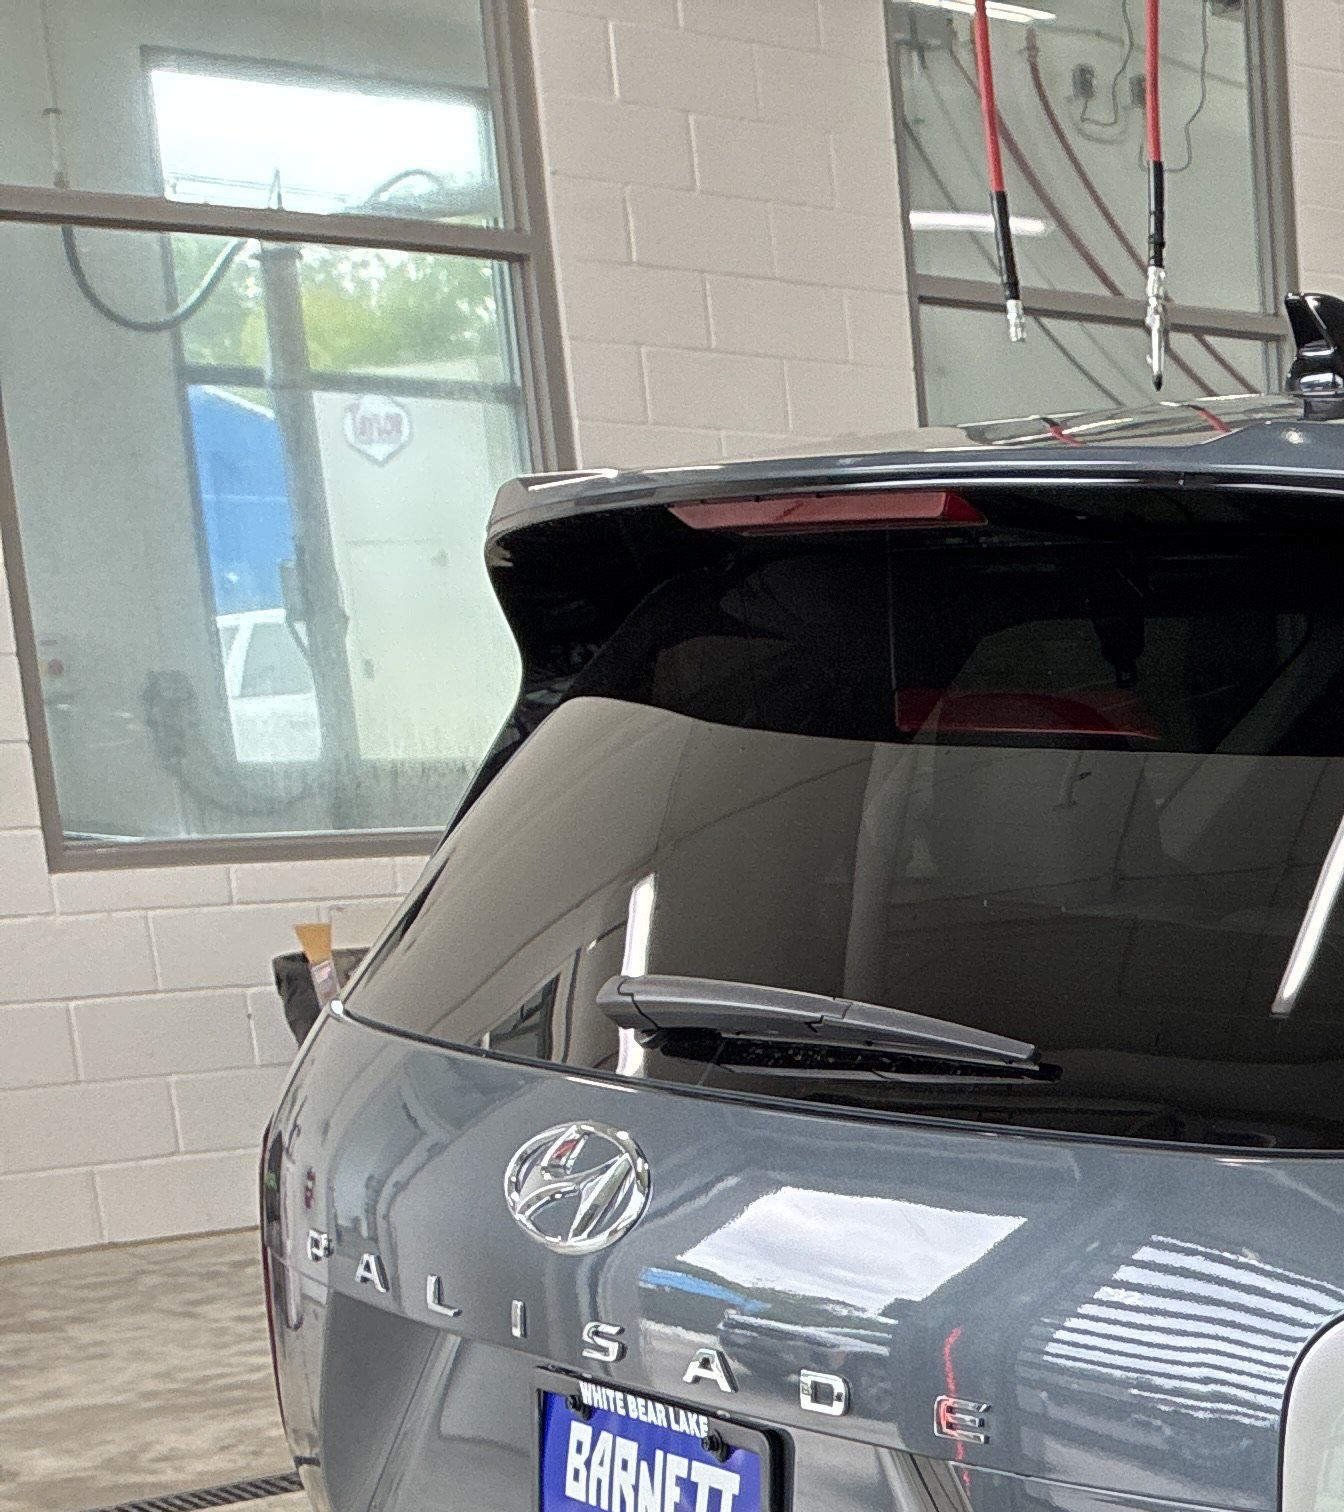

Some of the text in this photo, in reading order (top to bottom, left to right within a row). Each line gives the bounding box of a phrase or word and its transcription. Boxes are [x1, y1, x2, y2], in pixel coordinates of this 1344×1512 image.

[307, 1229, 990, 1444] PALISADE
[578, 1380, 709, 1438] WHITE BEAR LAKE
